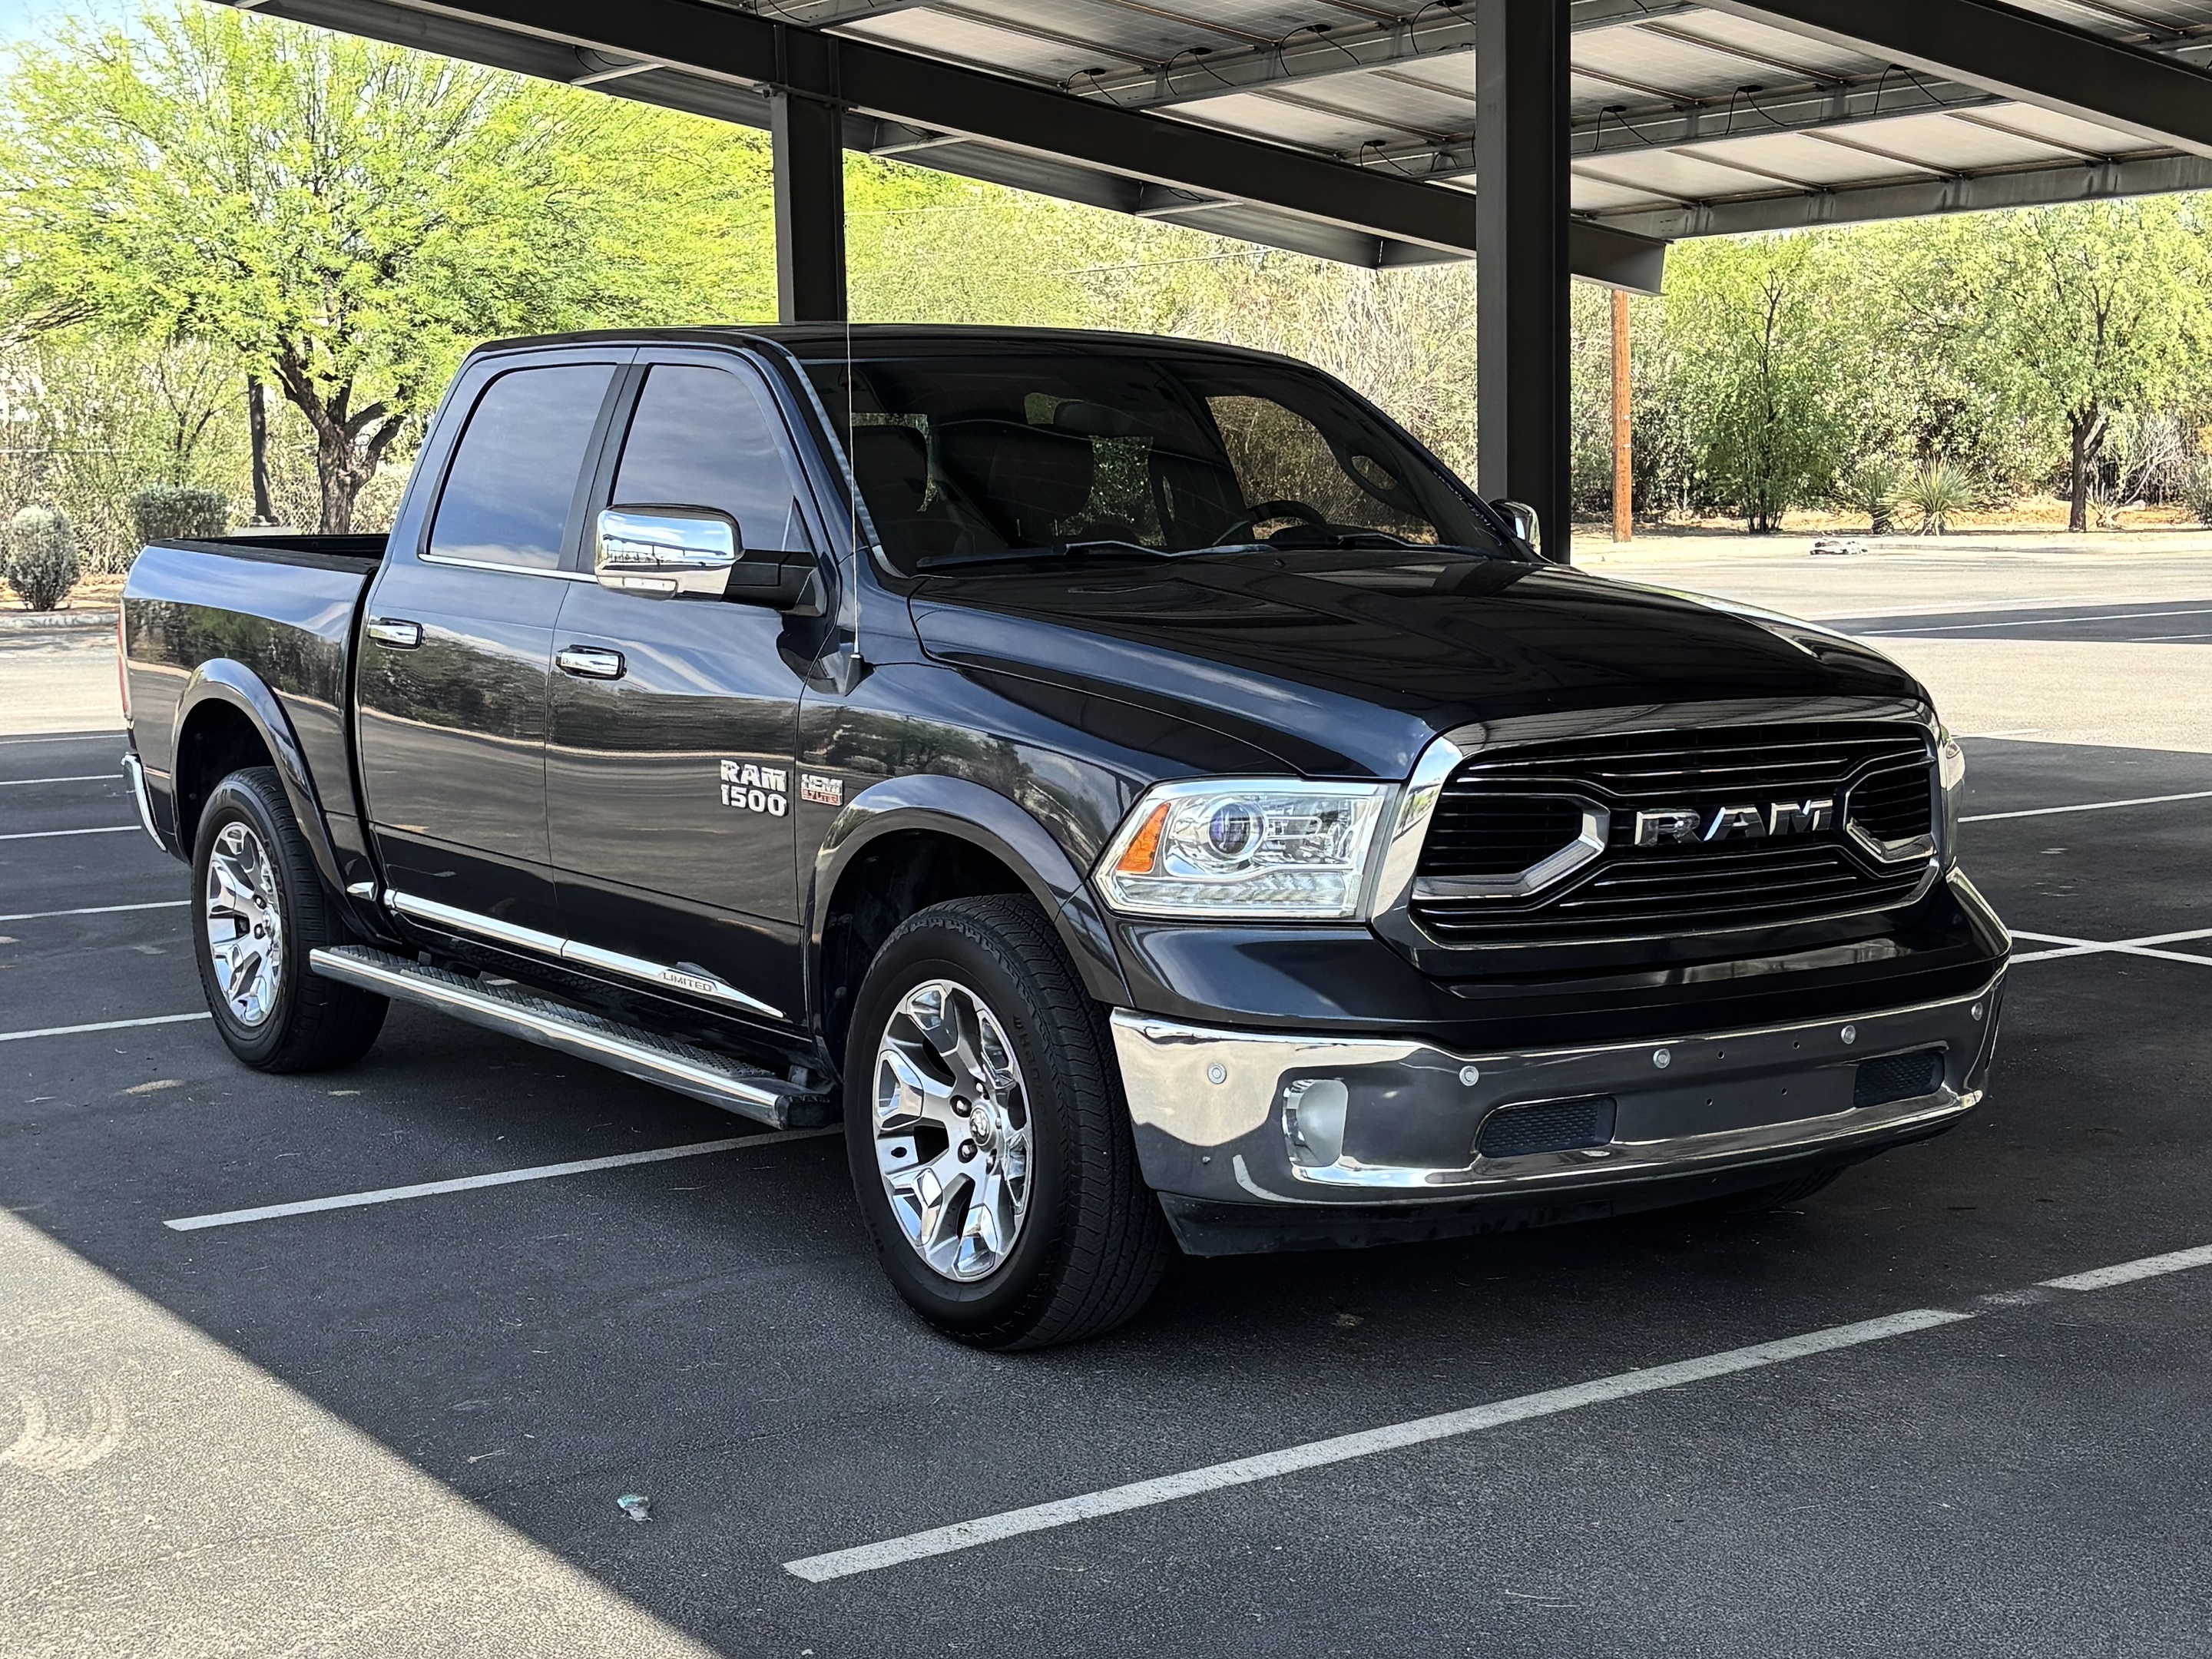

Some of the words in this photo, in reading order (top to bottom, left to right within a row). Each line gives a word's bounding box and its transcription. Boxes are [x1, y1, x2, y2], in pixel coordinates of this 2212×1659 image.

[720, 760, 786, 792] RAM
[720, 784, 787, 817] 1500
[1634, 797, 1833, 846] RAM
[663, 972, 712, 992] LIMITED
